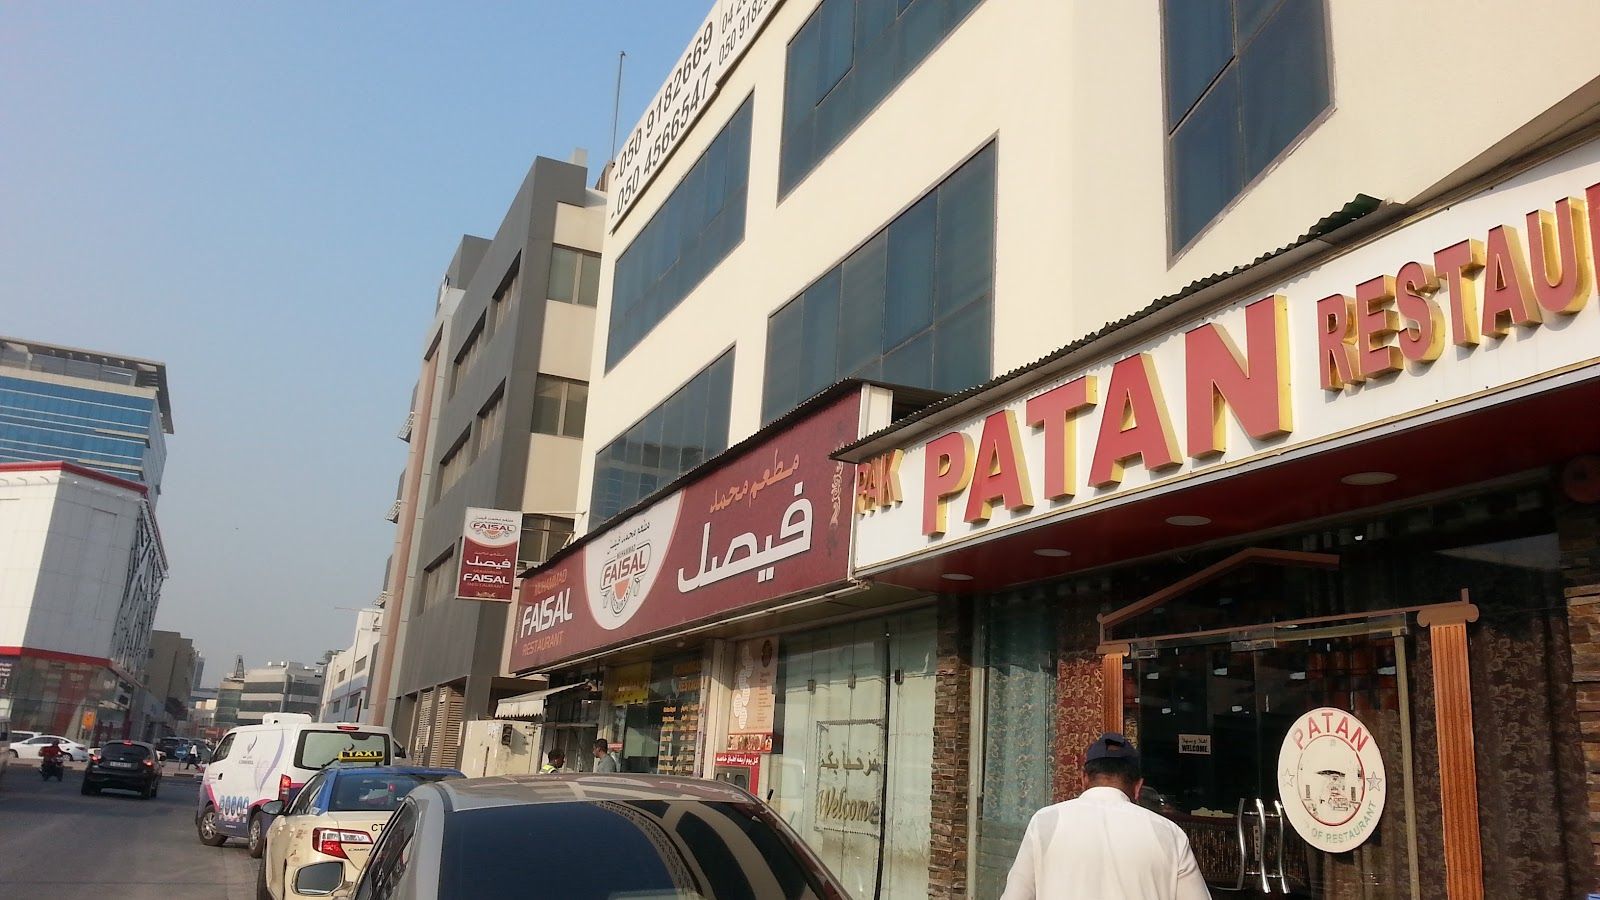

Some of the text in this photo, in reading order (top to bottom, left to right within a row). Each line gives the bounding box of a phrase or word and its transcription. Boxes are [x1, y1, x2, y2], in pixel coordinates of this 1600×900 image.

[722, 3, 733, 34] 04
[719, 28, 736, 66] 050
[646, 21, 713, 139] 9182669
[644, 62, 712, 175] 4566547
[922, 294, 1293, 539] PATAN
[473, 522, 513, 532] FAISAL
[678, 482, 813, 592] فيصل
[463, 573, 510, 585] FAISAL
[466, 555, 511, 569] فيصل
[603, 550, 646, 586] FAISAL
[520, 588, 573, 638] FAISAL
[522, 631, 565, 656] RESTAURANT
[1182, 744, 1208, 752] WELCOME
[1294, 712, 1369, 752] PATAN
[819, 786, 880, 824] Welcome
[1326, 801, 1377, 844] RESTAURANT
